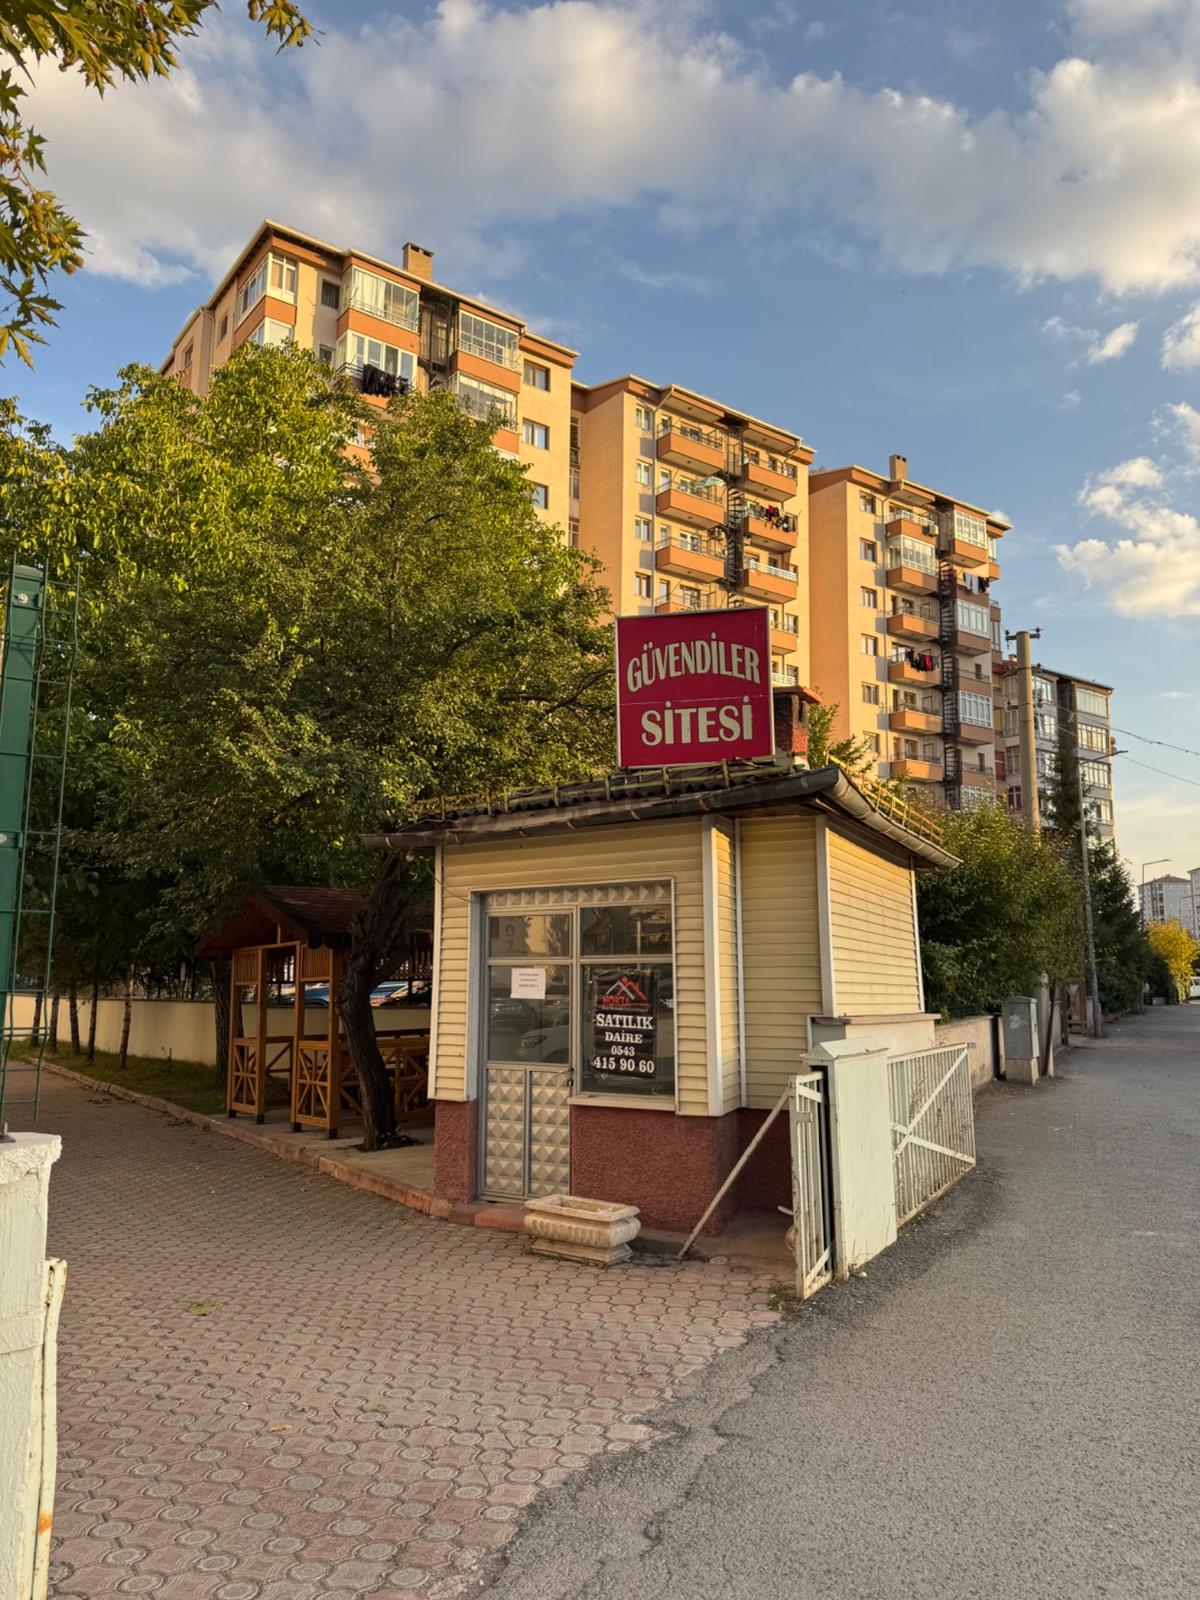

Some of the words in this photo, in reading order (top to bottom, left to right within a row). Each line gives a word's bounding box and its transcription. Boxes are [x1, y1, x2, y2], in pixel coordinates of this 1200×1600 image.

[627, 631, 761, 693] GÜVENDİLER
[640, 695, 754, 747] SİTESİ
[596, 1013, 654, 1030] SATILIK
[605, 1030, 643, 1044] DAİRE
[611, 1045, 635, 1057] 0543
[593, 1056, 616, 1070] 415
[619, 1058, 636, 1072] 90
[639, 1060, 655, 1074] 60
